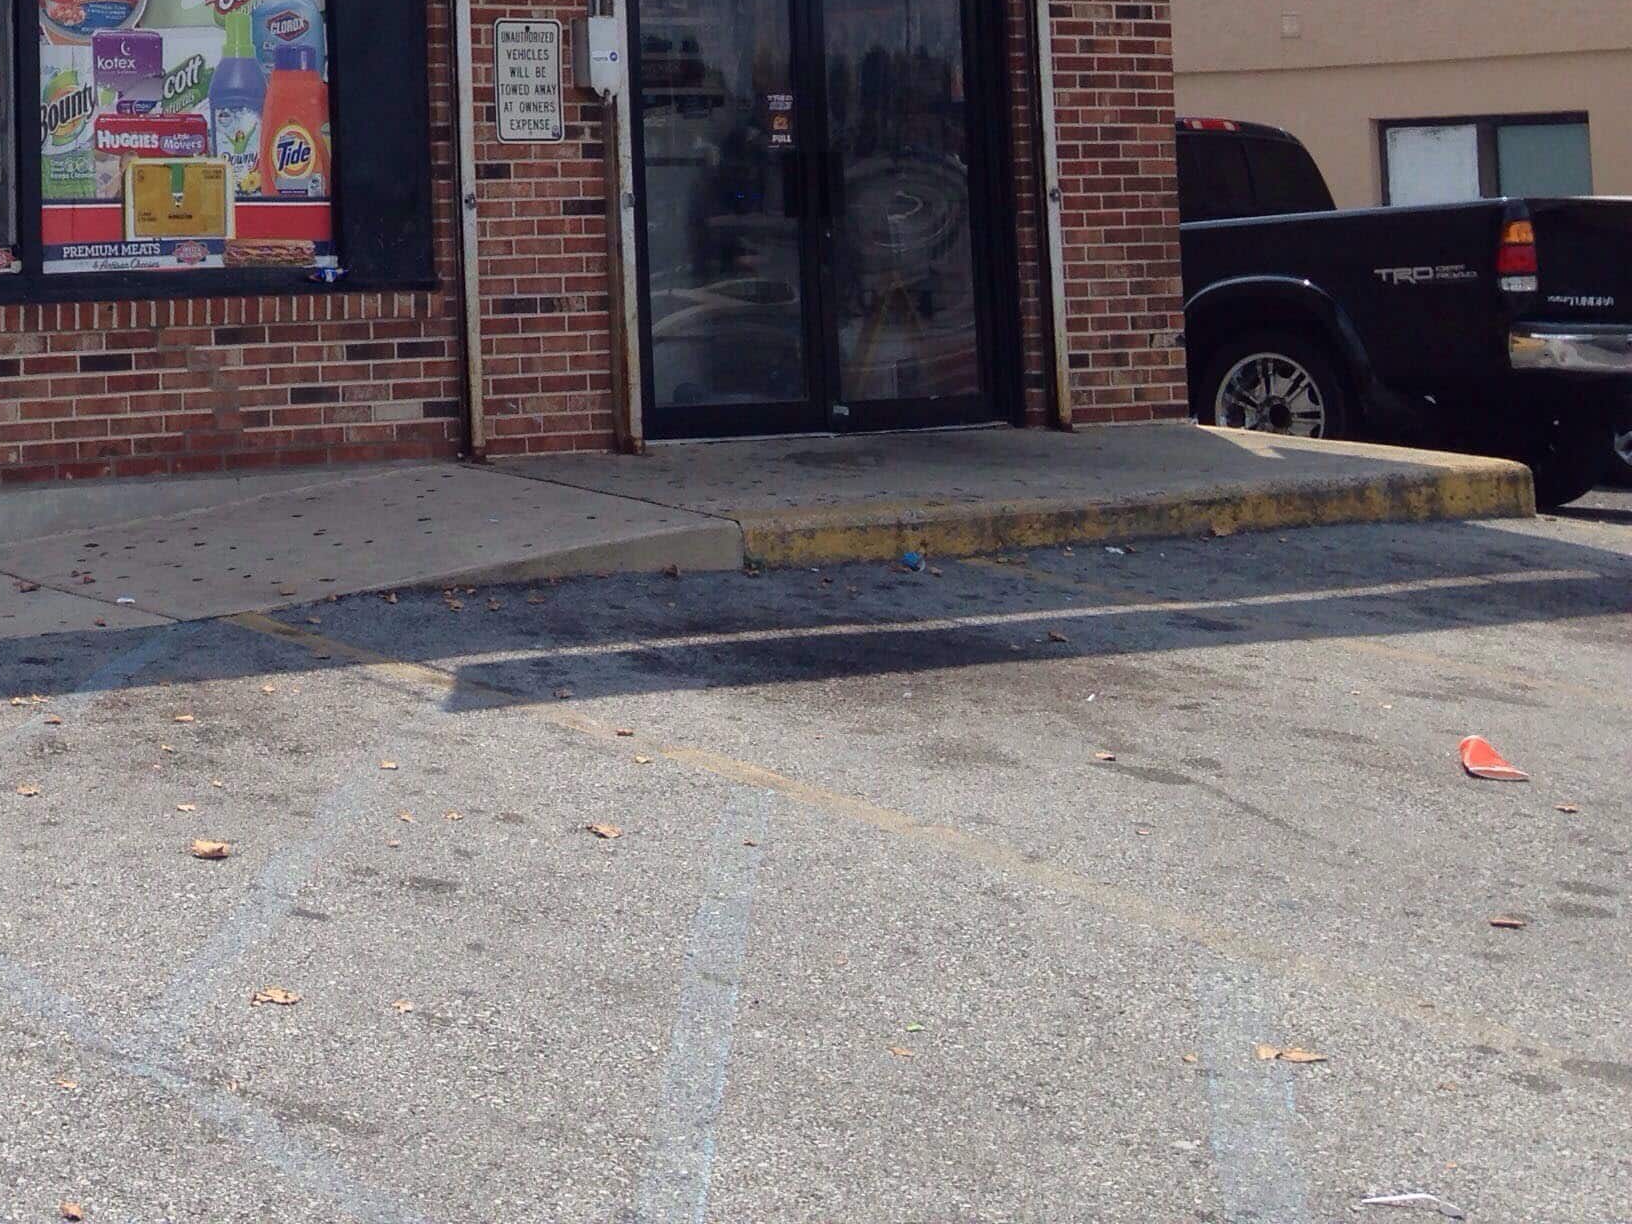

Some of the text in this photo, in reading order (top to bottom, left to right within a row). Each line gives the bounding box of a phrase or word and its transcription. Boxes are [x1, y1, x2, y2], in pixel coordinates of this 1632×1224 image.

[270, 17, 306, 35] CLOROX
[500, 32, 554, 43] UNAUTHORIZED
[97, 55, 136, 70] kotex
[506, 49, 550, 61] VEHICLES
[163, 55, 203, 100] cott
[509, 67, 547, 78] WILL BE
[500, 84, 557, 96] TOWED AWAY
[503, 102, 556, 114] AT OWNERS
[510, 119, 551, 131] EXPENSE
[97, 130, 159, 149] HUGGIES
[277, 141, 312, 172] Tide
[63, 243, 161, 259] PREMIUM MEATS
[1374, 266, 1435, 285] TRD
